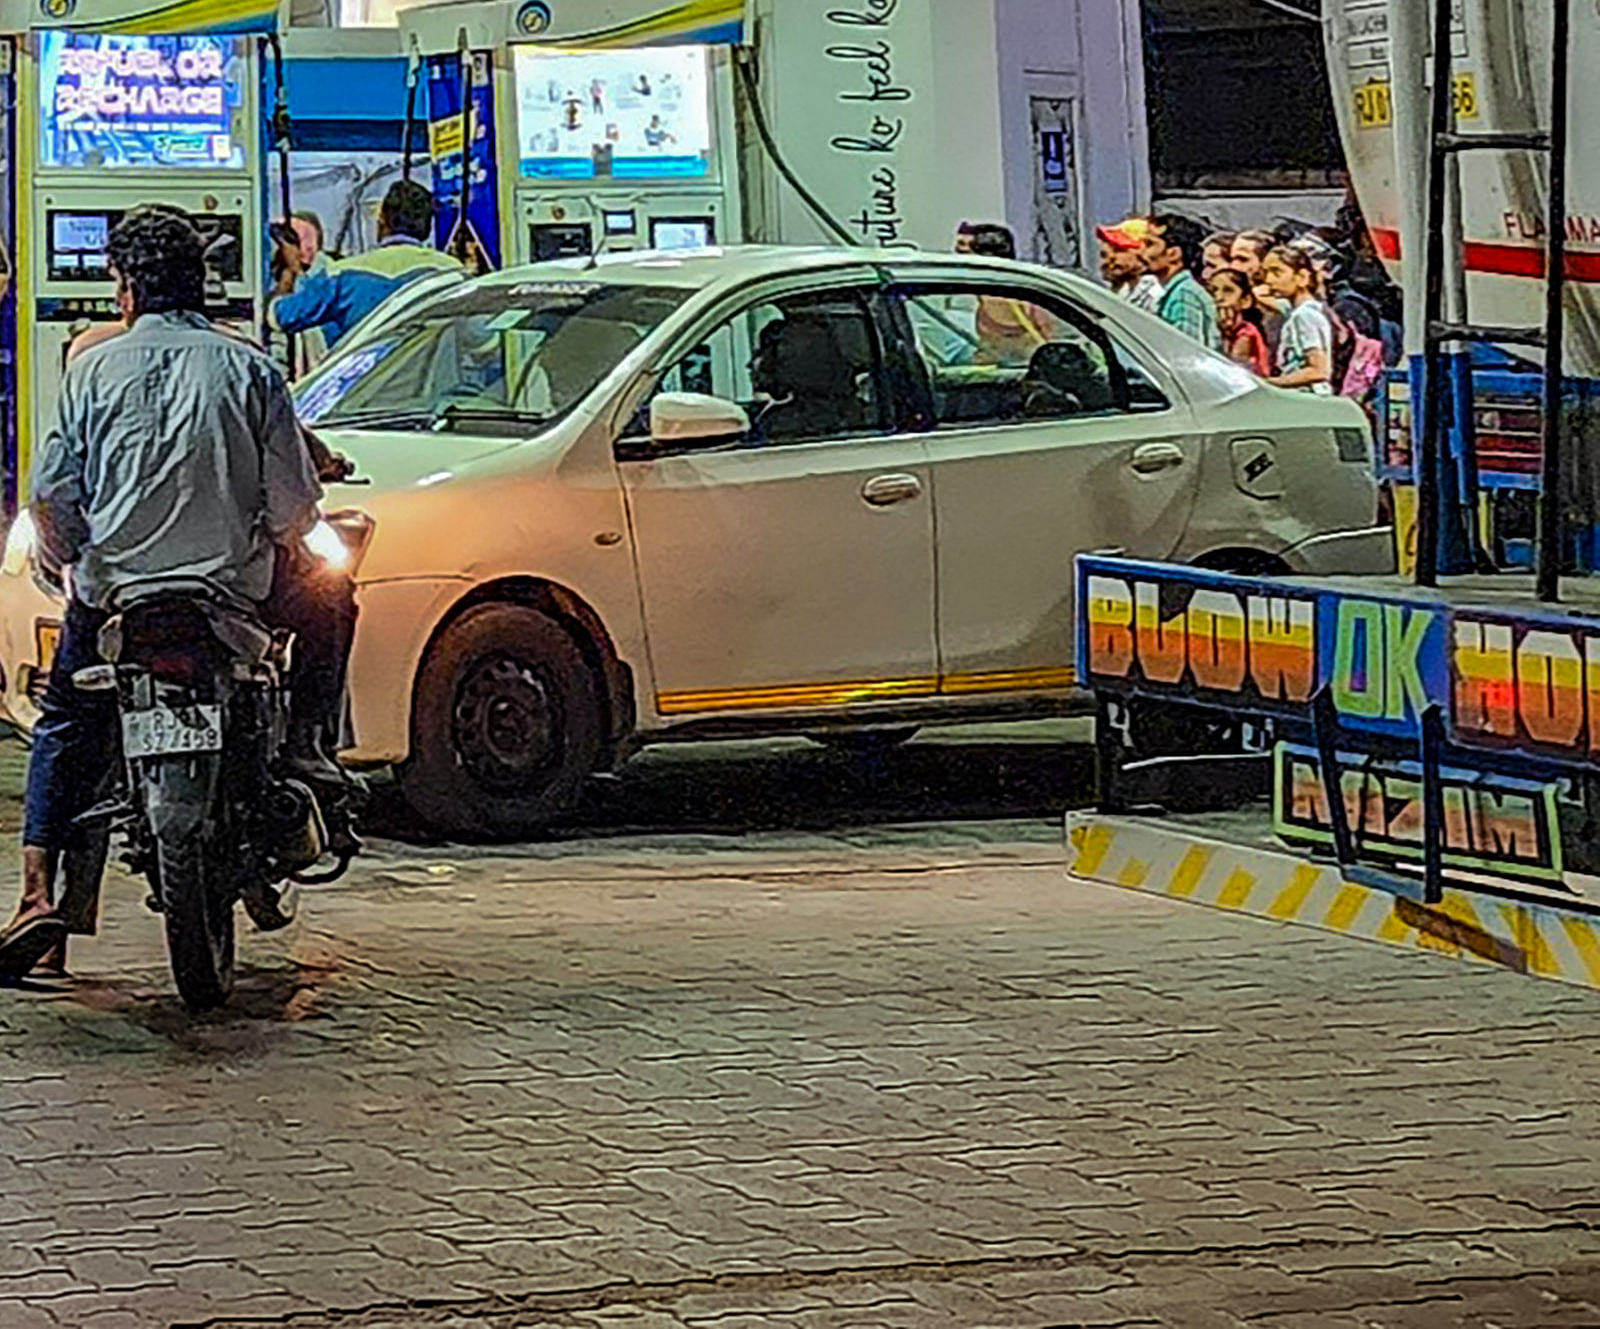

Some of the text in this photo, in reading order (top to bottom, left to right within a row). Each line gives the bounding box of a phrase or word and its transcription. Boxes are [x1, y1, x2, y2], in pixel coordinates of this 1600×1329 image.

[825, 40, 911, 101] feel
[1087, 574, 1317, 704] BLOW
[1330, 598, 1435, 720] OK
